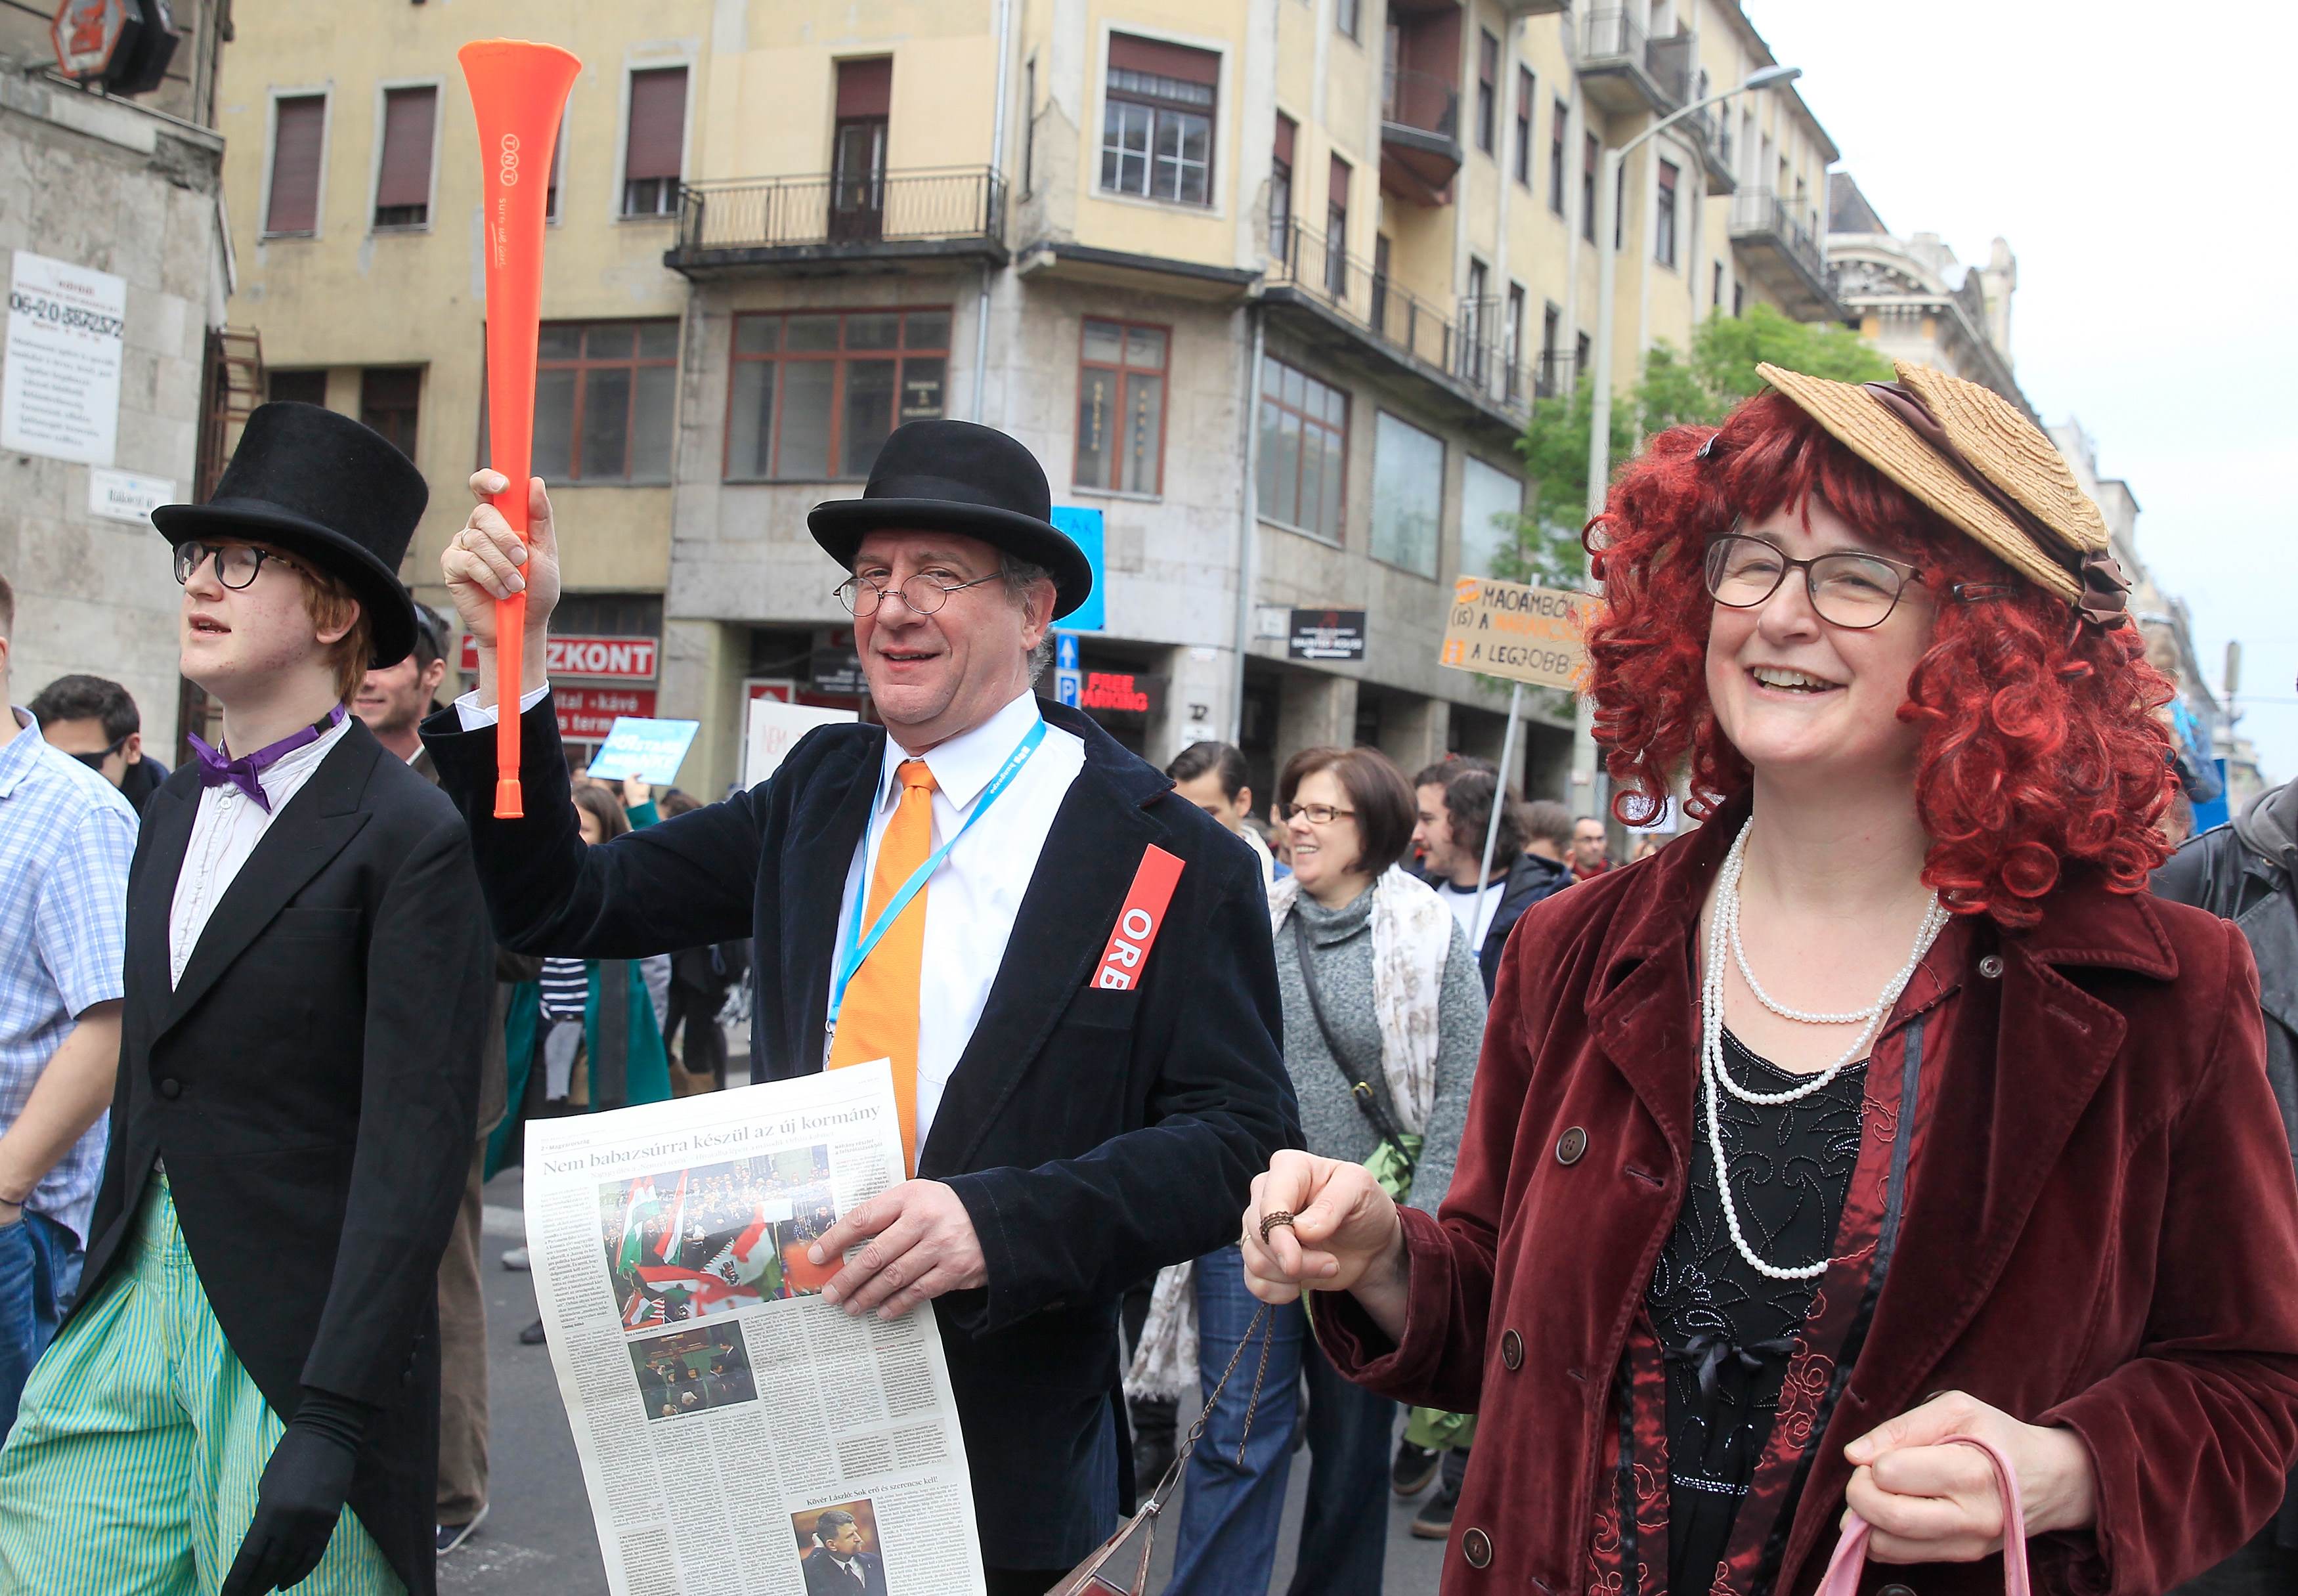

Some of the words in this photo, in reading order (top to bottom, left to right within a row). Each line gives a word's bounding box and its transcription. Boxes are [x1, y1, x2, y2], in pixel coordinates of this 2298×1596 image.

[501, 134, 519, 186] TNT
[1479, 613, 1489, 630] A
[548, 642, 652, 674] ZKONT
[1471, 643, 1481, 659] A
[1488, 645, 1571, 675] LEGJOBB
[557, 691, 583, 710] ital
[573, 713, 614, 733] term
[1099, 908, 1153, 990] ORB
[543, 1158, 584, 1175] Nem
[590, 1140, 687, 1166] babazsúrra
[693, 1127, 748, 1148] készül
[755, 1126, 774, 1137] az
[780, 1121, 796, 1135] új
[802, 1106, 880, 1130] kormány
[806, 1496, 827, 1506] Kövér
[828, 1491, 852, 1501] László:
[853, 1488, 866, 1497] Sok
[867, 1486, 879, 1494] erő
[889, 1479, 922, 1490] szerencse
[923, 1475, 938, 1484] kell!
